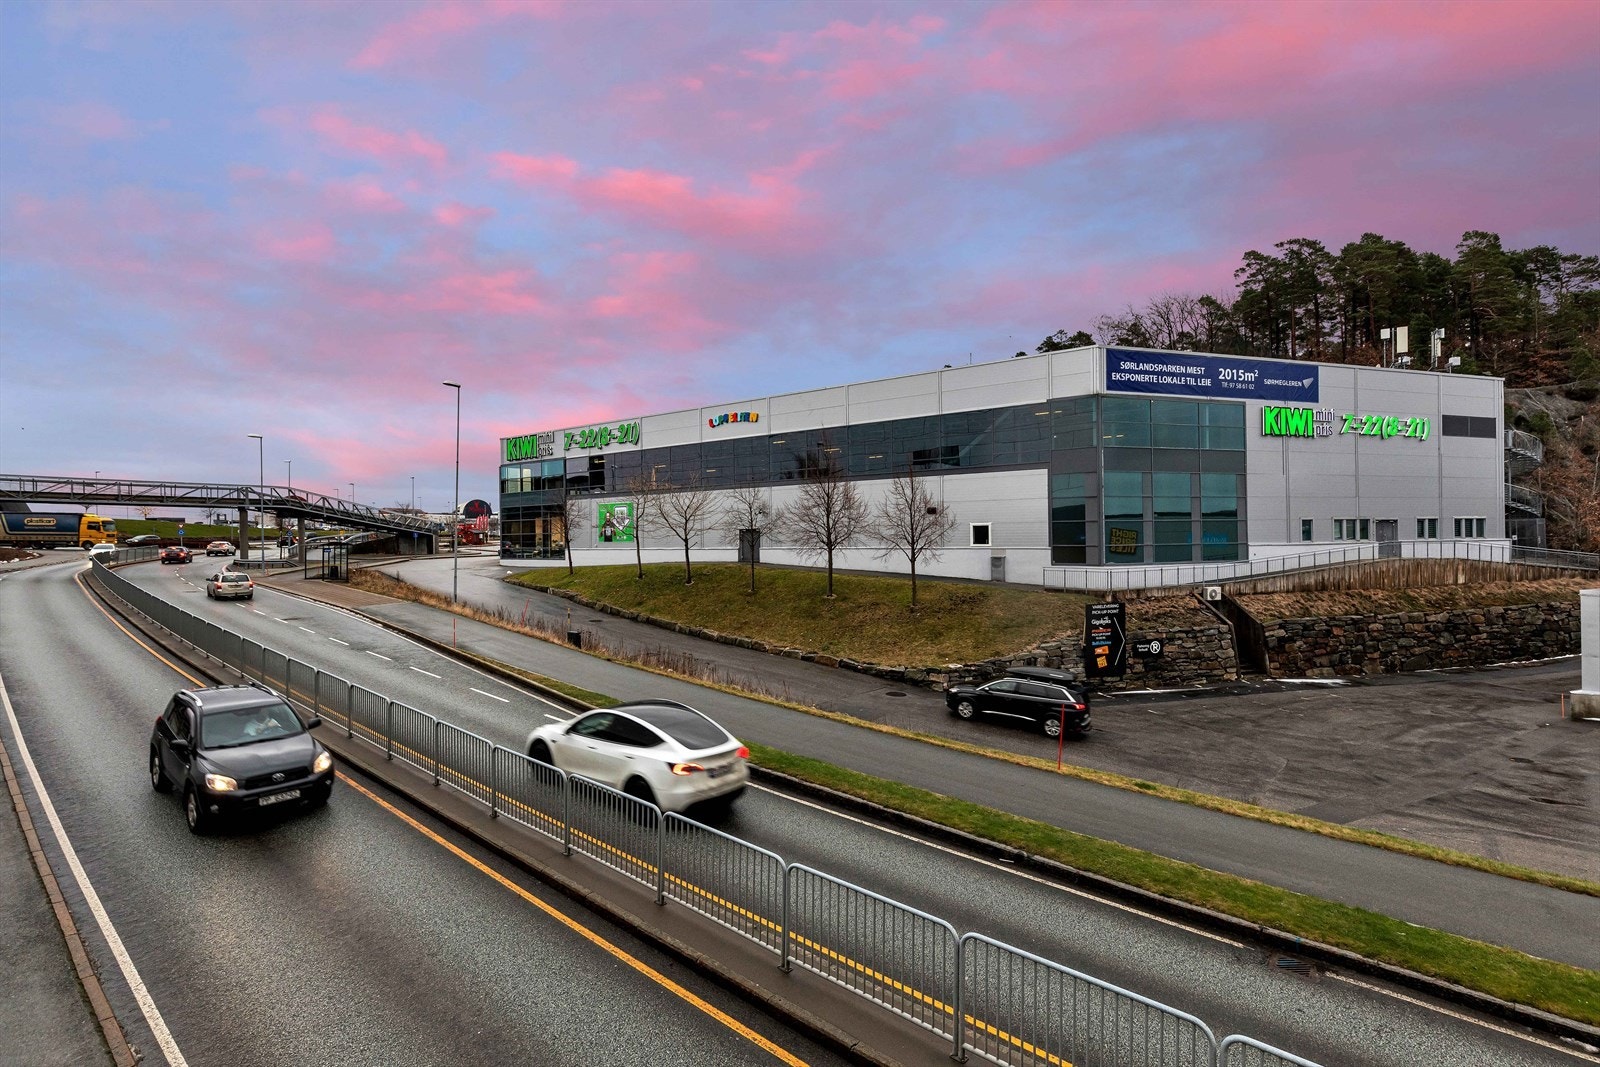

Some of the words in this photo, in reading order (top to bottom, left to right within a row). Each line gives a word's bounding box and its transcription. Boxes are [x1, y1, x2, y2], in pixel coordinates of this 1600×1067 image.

[1120, 361, 1186, 374] SØRLANDSPARKEN
[1186, 367, 1205, 375] MEST
[1111, 372, 1158, 383] EKSPONERTE
[1158, 376, 1186, 385] LOKALE
[1186, 377, 1197, 386] TIL
[1197, 379, 1212, 387] LEIE
[1263, 378, 1303, 387] SØRMEGLEREN
[1262, 405, 1315, 438] KIWI
[1314, 408, 1335, 421] mini
[1314, 422, 1334, 438] pris
[506, 433, 539, 462] KIWI
[538, 431, 555, 445] mini
[538, 444, 554, 457] pris
